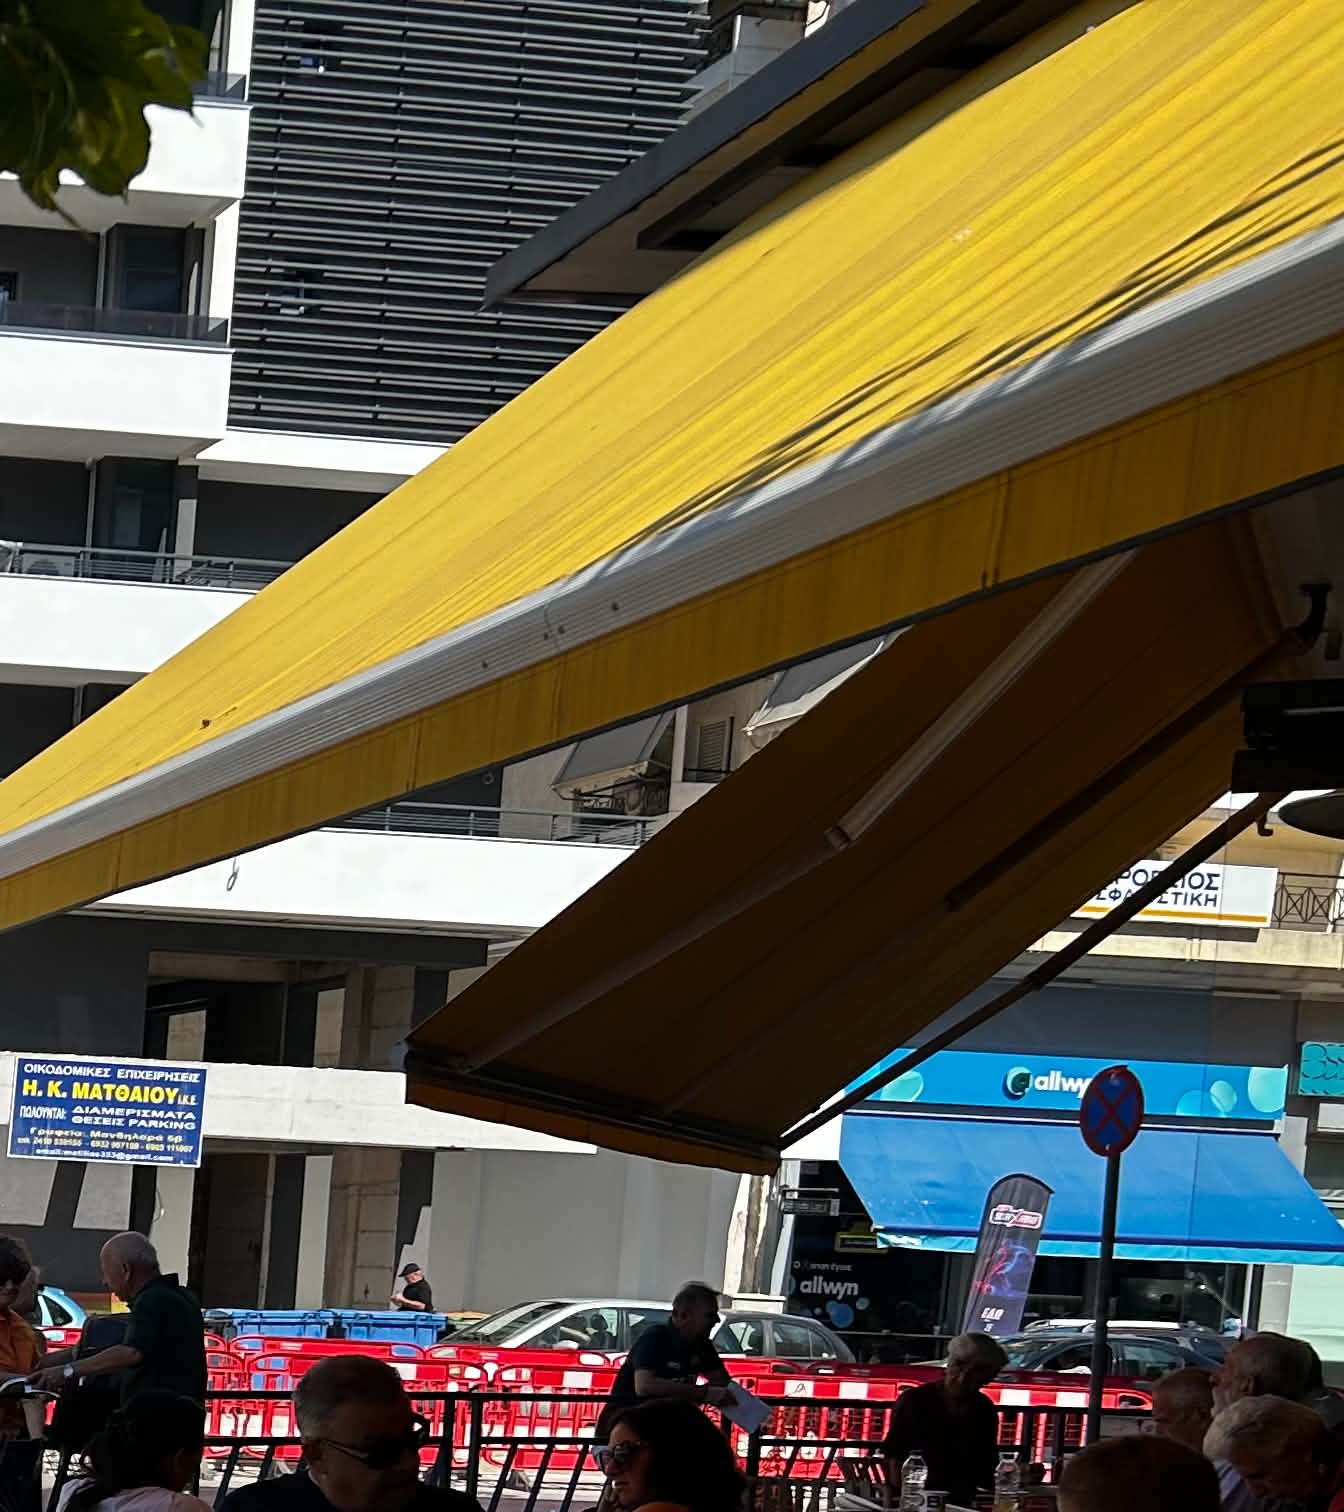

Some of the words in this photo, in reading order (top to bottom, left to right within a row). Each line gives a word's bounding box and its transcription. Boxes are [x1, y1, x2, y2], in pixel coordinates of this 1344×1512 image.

[23, 1063, 112, 1078] ΟΙΚΟΔΟΜΙΚΕΣ
[116, 1068, 201, 1083] ΕΠΙΧΕΙΡΗΣΕΙΣ
[23, 1079, 43, 1097] Η.
[47, 1080, 68, 1099] Κ.
[72, 1081, 179, 1105] ΜΑΤΘΑΙΟΥ
[1034, 1070, 1093, 1099] allwy
[72, 1105, 196, 1120] ΔΙΑΜΕΡΙΣΜΑΤΑ
[72, 1115, 125, 1126] ΘΕΣΕΙΣ
[128, 1119, 196, 1130] PARKING
[799, 1275, 859, 1300] allwyn
